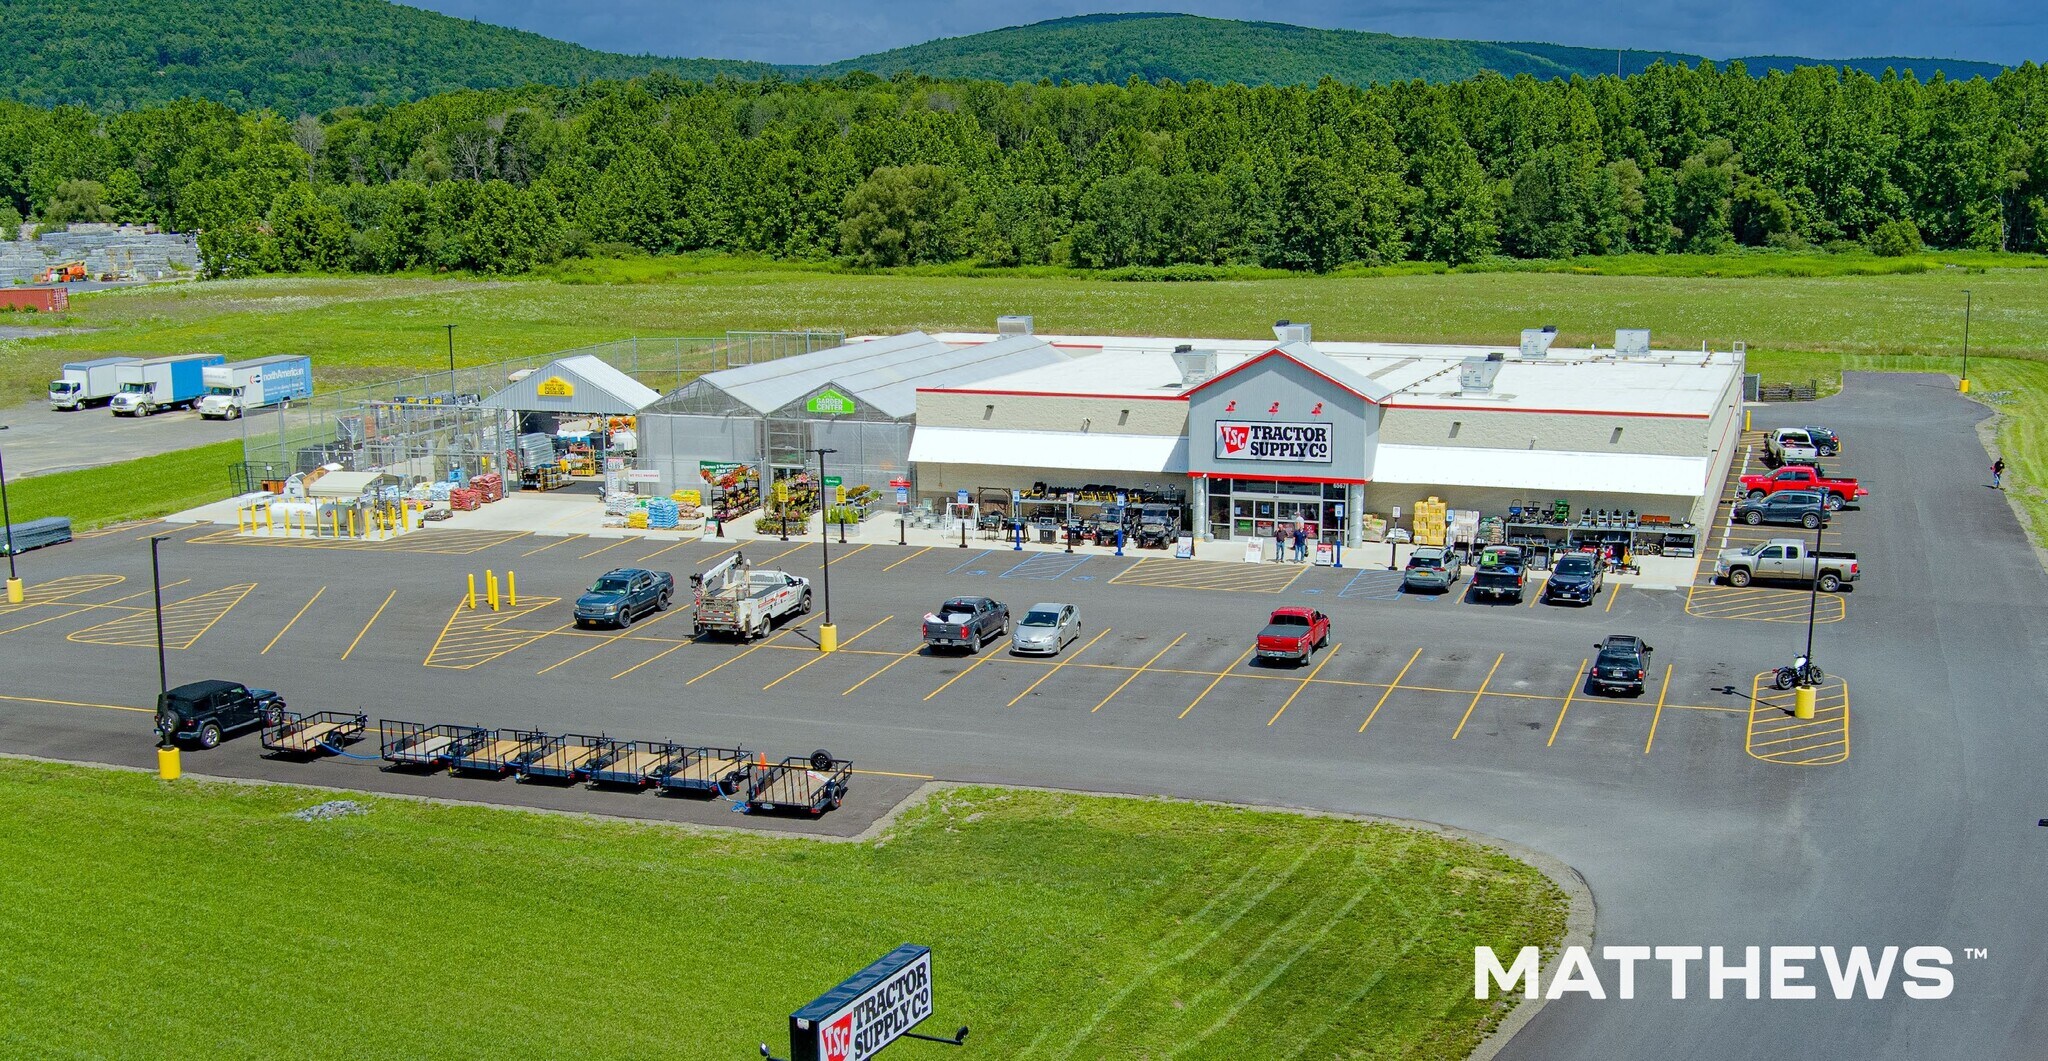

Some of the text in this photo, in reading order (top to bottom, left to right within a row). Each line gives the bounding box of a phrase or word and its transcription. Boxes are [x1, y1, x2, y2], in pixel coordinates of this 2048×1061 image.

[263, 368, 304, 381] northAmerican
[816, 397, 843, 405] GARDEN
[1223, 427, 1245, 449] TSC
[1250, 426, 1327, 442] TRACTOR
[1250, 441, 1307, 457] SUPPLY
[853, 962, 927, 1030] TRACTOR
[854, 1000, 911, 1061] SUPPLY
[825, 1025, 849, 1056] TSC
